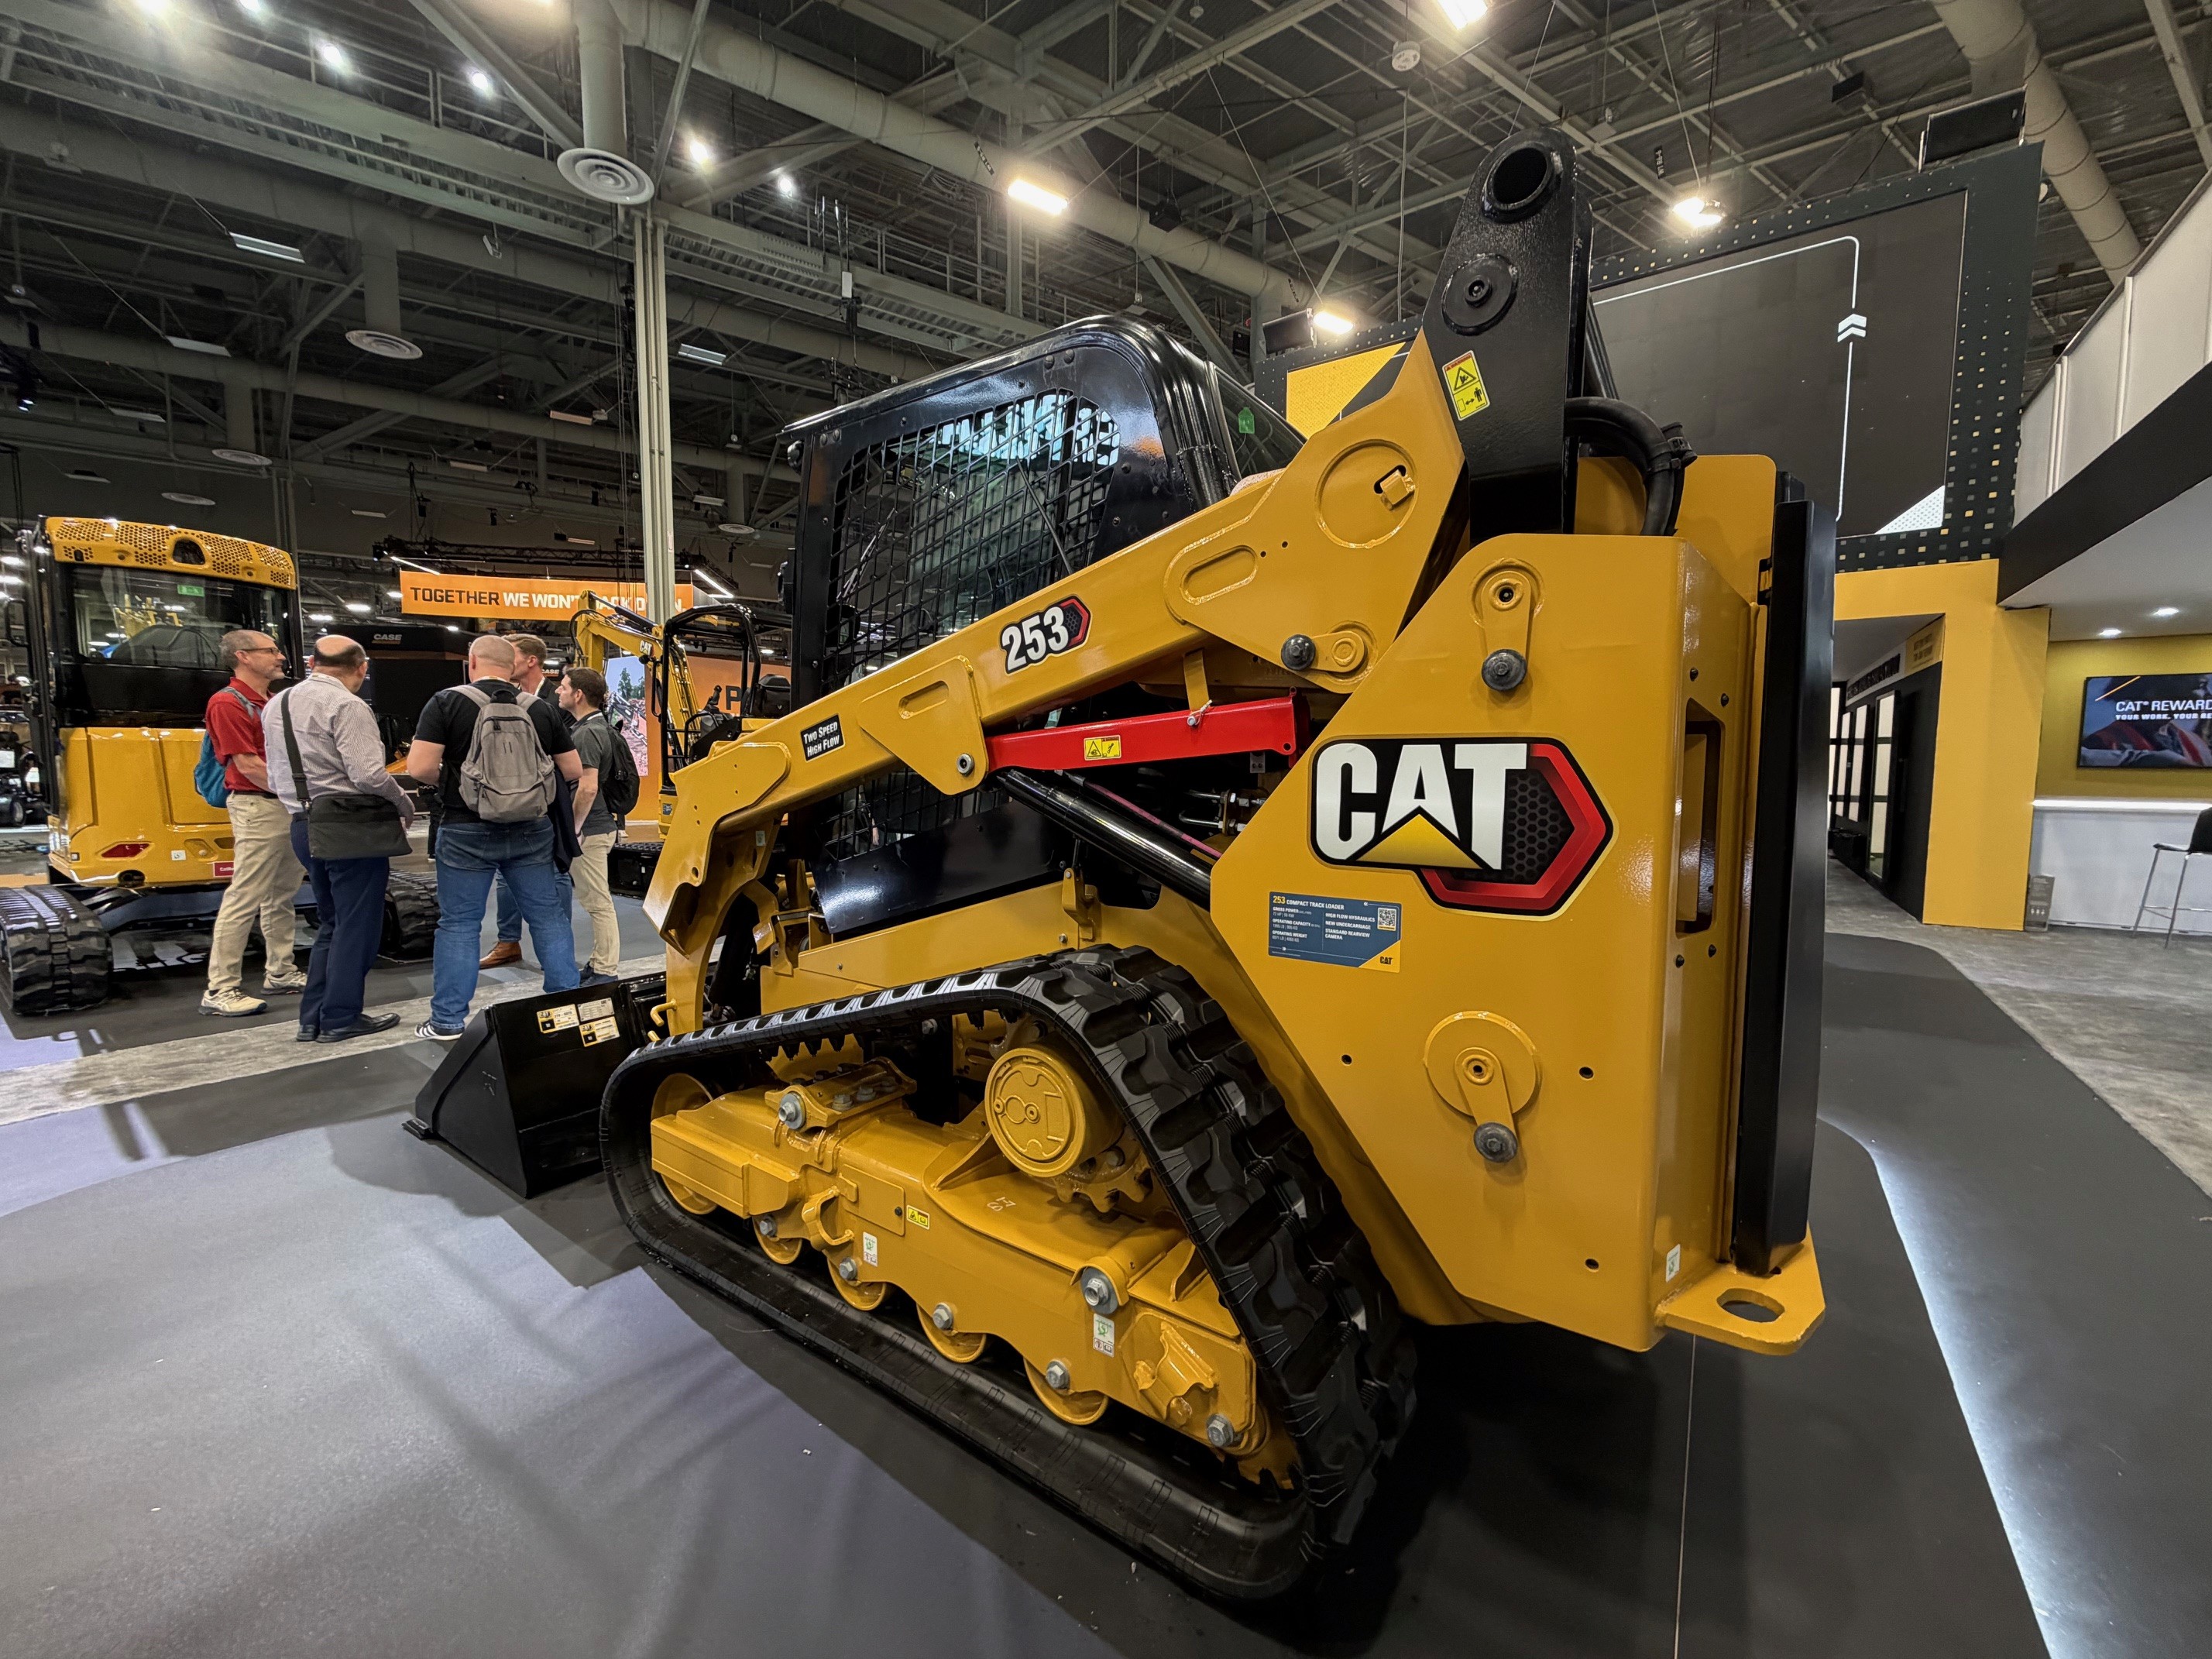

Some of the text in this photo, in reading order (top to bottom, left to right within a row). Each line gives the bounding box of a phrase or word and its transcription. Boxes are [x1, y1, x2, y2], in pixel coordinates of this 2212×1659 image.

[410, 586, 500, 606] TOGETHER
[503, 592, 530, 607] WE
[1001, 606, 1069, 672] 253
[640, 640, 652, 656] CAT
[1317, 743, 1527, 870] CAT
[1273, 895, 1286, 905] 253
[1336, 922, 1372, 930] UNDERCARRIAGE
[1379, 956, 1393, 965] CAT
